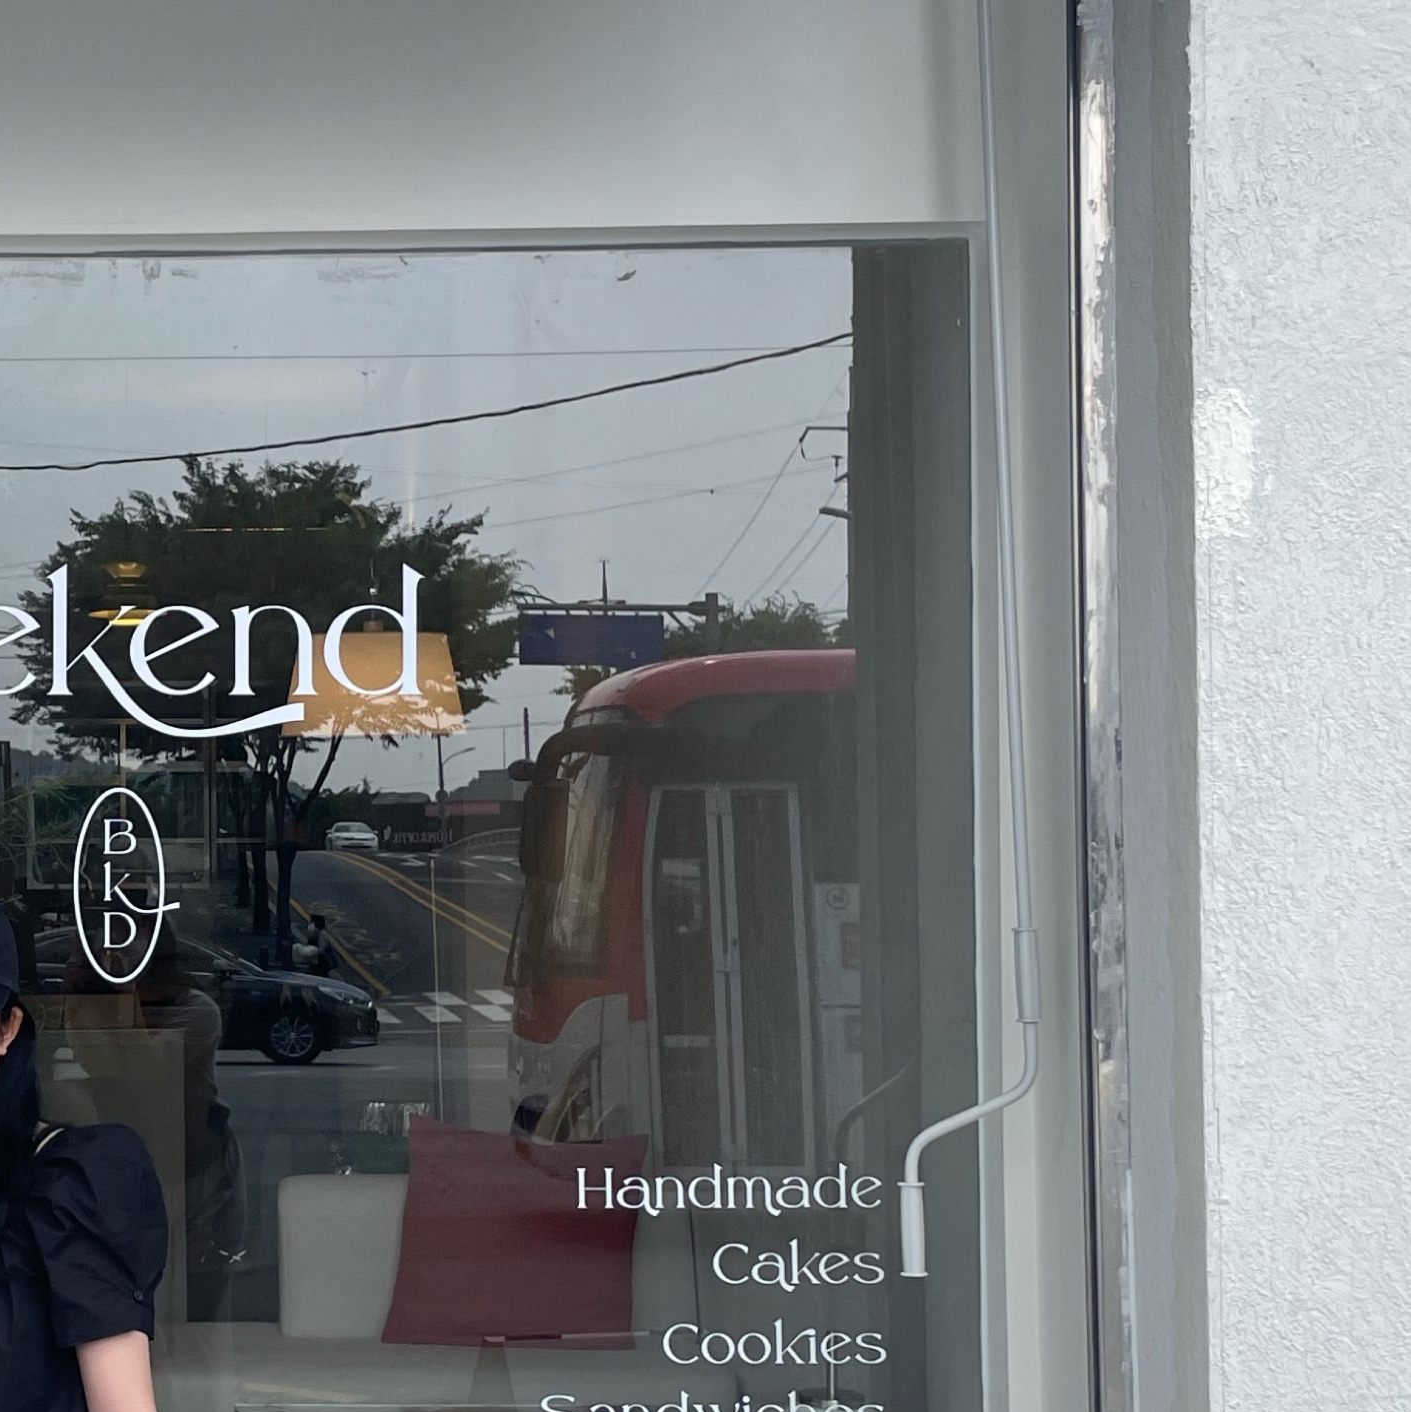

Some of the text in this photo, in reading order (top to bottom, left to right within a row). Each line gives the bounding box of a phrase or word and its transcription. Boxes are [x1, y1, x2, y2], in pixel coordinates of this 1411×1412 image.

[575, 1161, 882, 1217] Handmade
[711, 1238, 886, 1293] Cakes
[661, 1318, 888, 1366] Cookies
